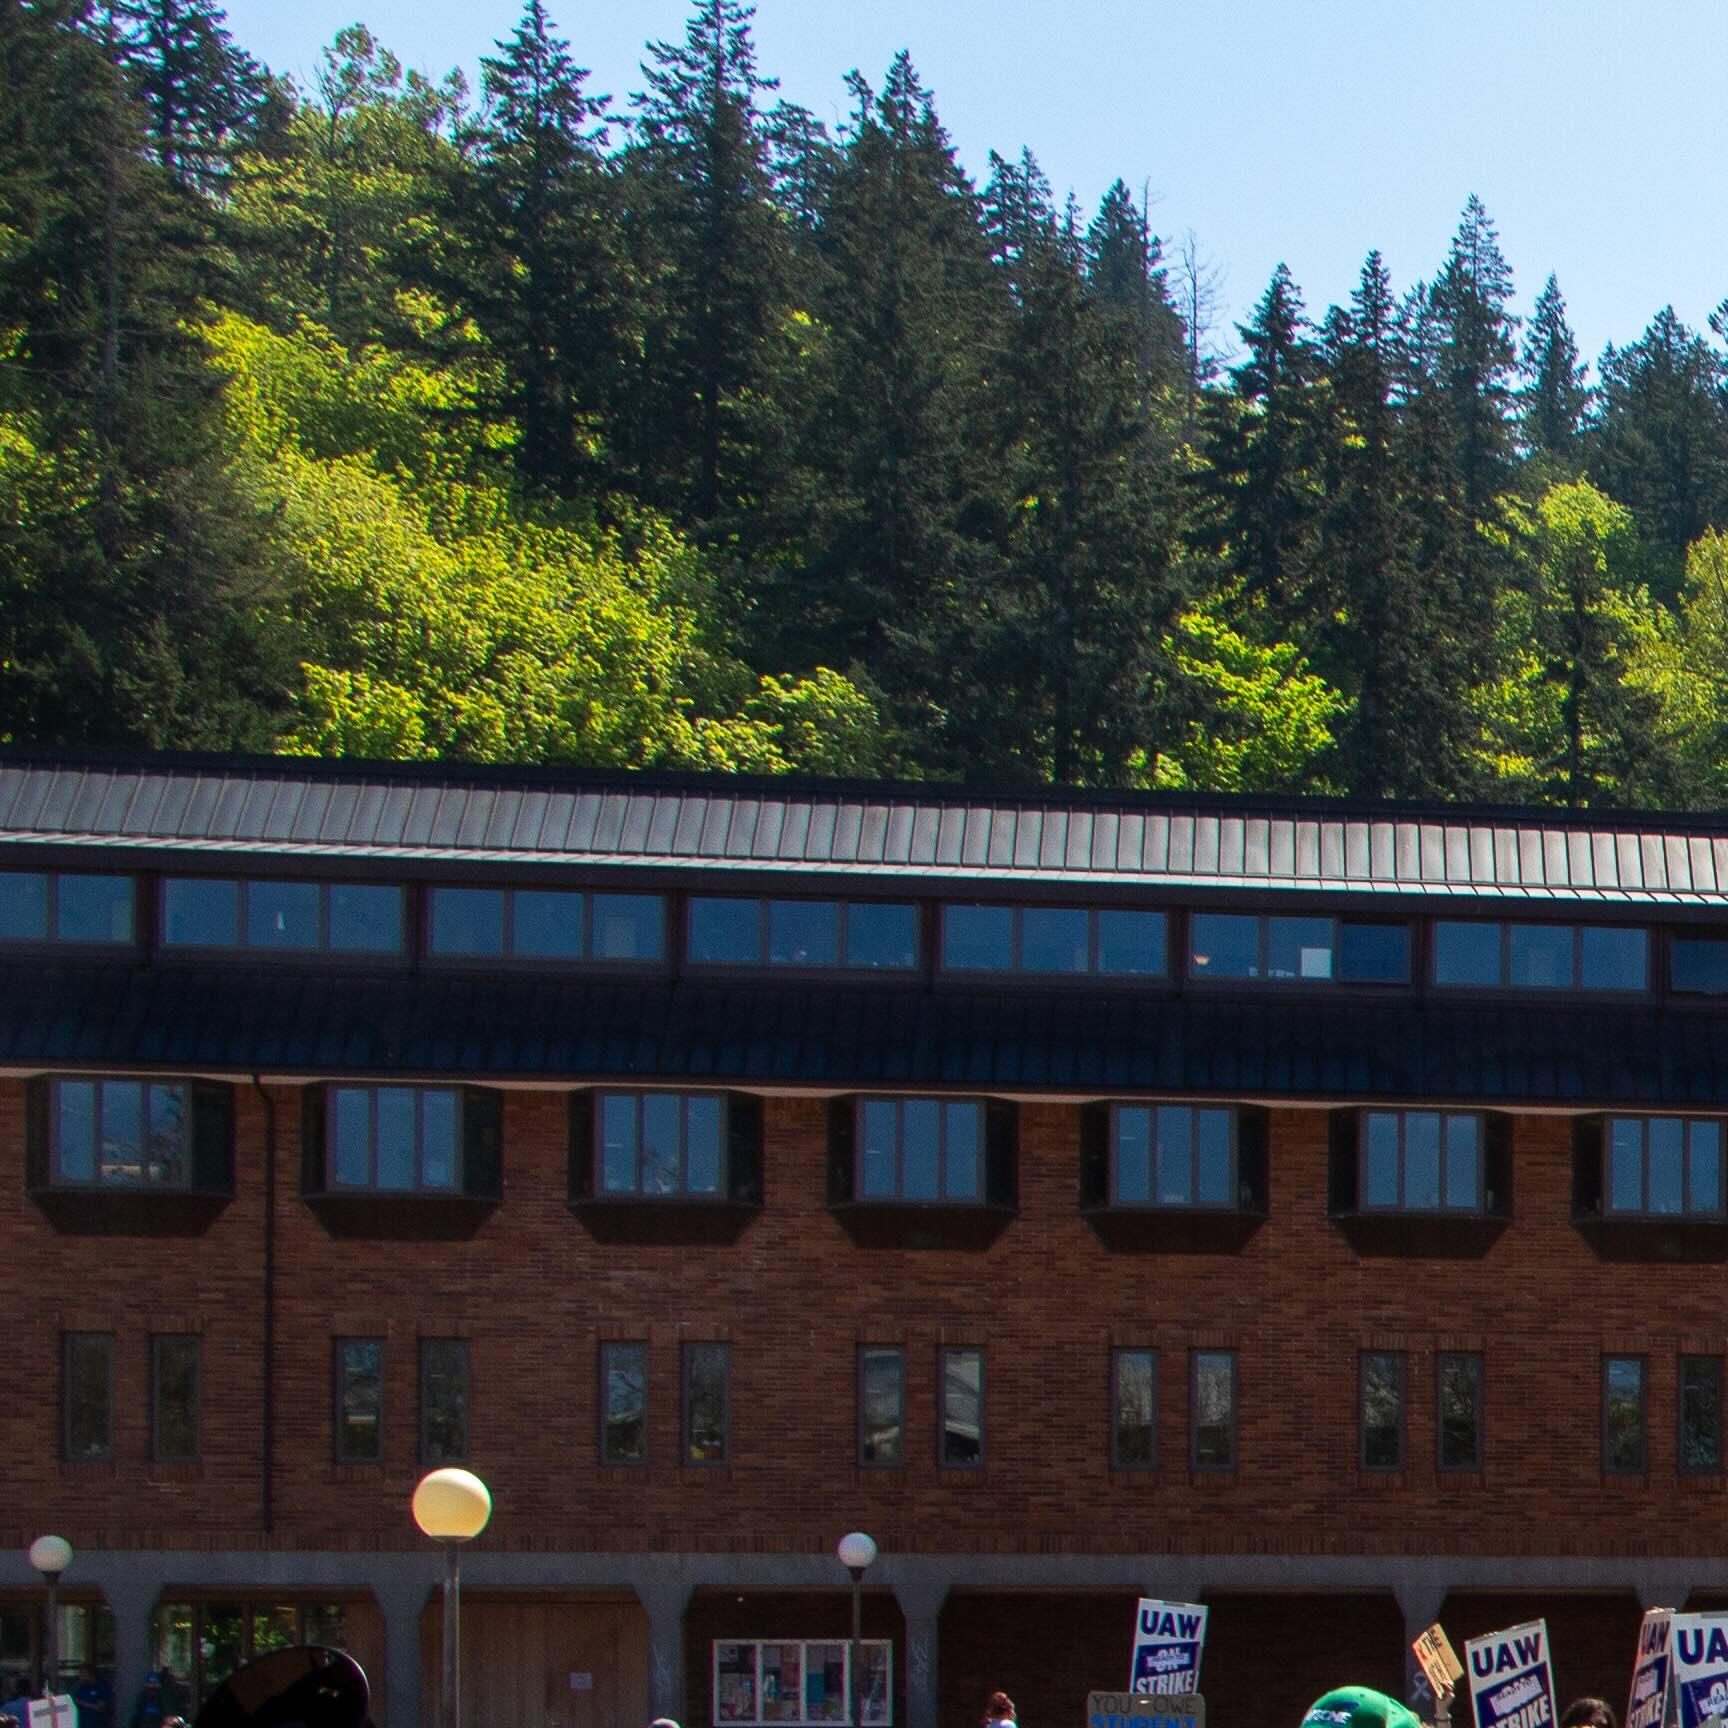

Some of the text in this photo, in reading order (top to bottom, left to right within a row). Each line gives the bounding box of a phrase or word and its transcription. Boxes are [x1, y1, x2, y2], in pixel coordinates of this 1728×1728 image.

[1141, 1609, 1201, 1639] UAW
[1472, 1632, 1541, 1678] UAW
[1136, 1670, 1194, 1695] STRIKE
[1092, 1695, 1195, 1714] YOU OWE
